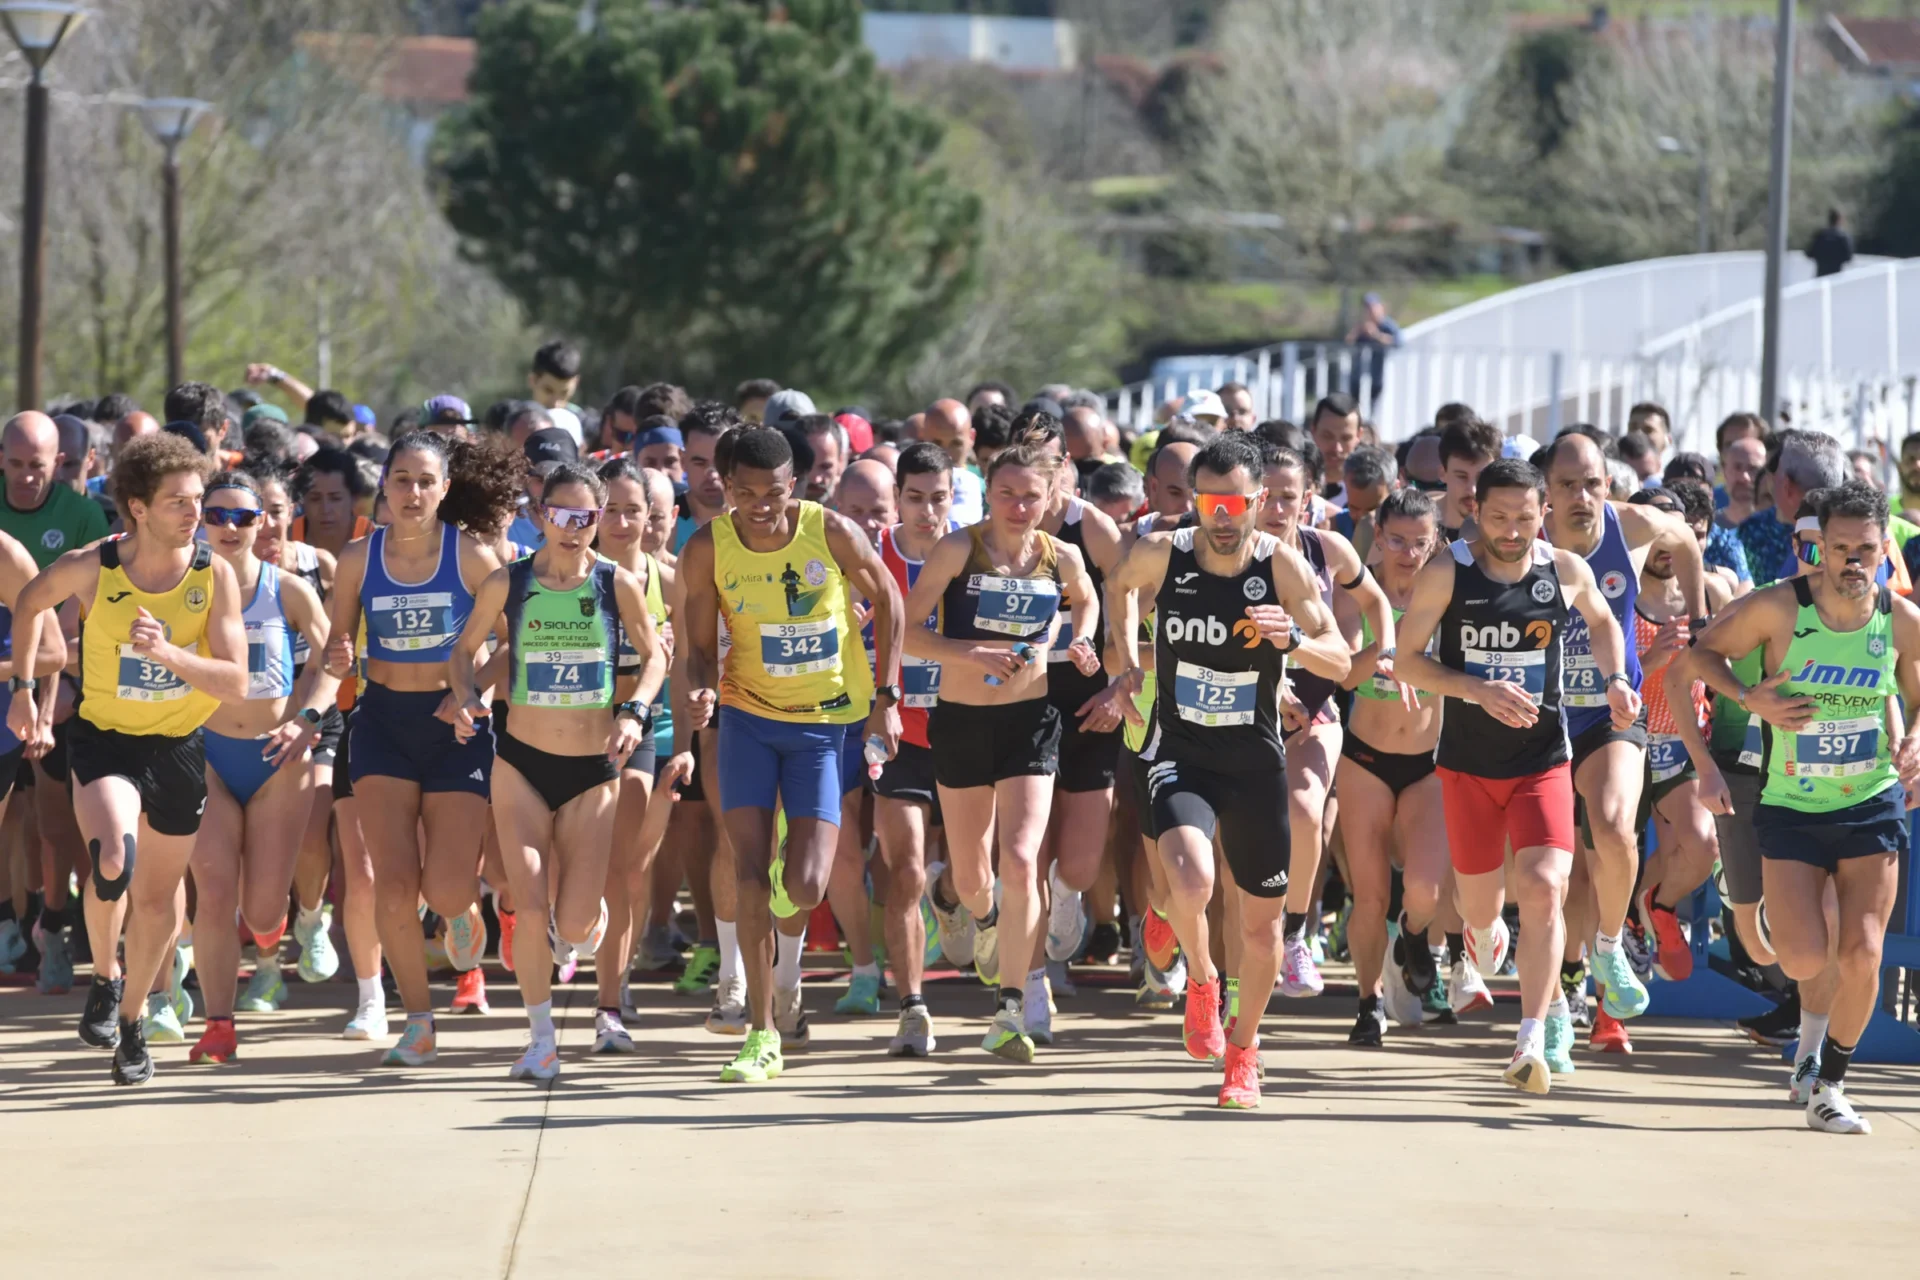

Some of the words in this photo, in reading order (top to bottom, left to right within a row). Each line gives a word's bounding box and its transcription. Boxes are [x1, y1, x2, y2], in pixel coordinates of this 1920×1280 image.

[539, 442, 561, 452] FILA
[741, 573, 763, 583] Mira
[1001, 579, 1018, 592] 39
[391, 596, 408, 609] 39
[1006, 594, 1034, 615] 97
[392, 608, 433, 630] 132
[779, 625, 796, 637] 39
[1165, 615, 1227, 646] pnb
[1460, 621, 1521, 652] pnb
[780, 636, 823, 657] 342
[1563, 646, 1592, 656] MILY
[544, 651, 562, 662] 39
[1485, 652, 1503, 665] 39
[552, 664, 580, 684] 74
[1197, 667, 1214, 682] 39
[1485, 667, 1526, 687] 123
[1567, 669, 1594, 687] 78
[1196, 683, 1237, 705] 125
[1817, 722, 1836, 734] 39
[1648, 743, 1674, 763] 32
[1818, 734, 1861, 756] 597
